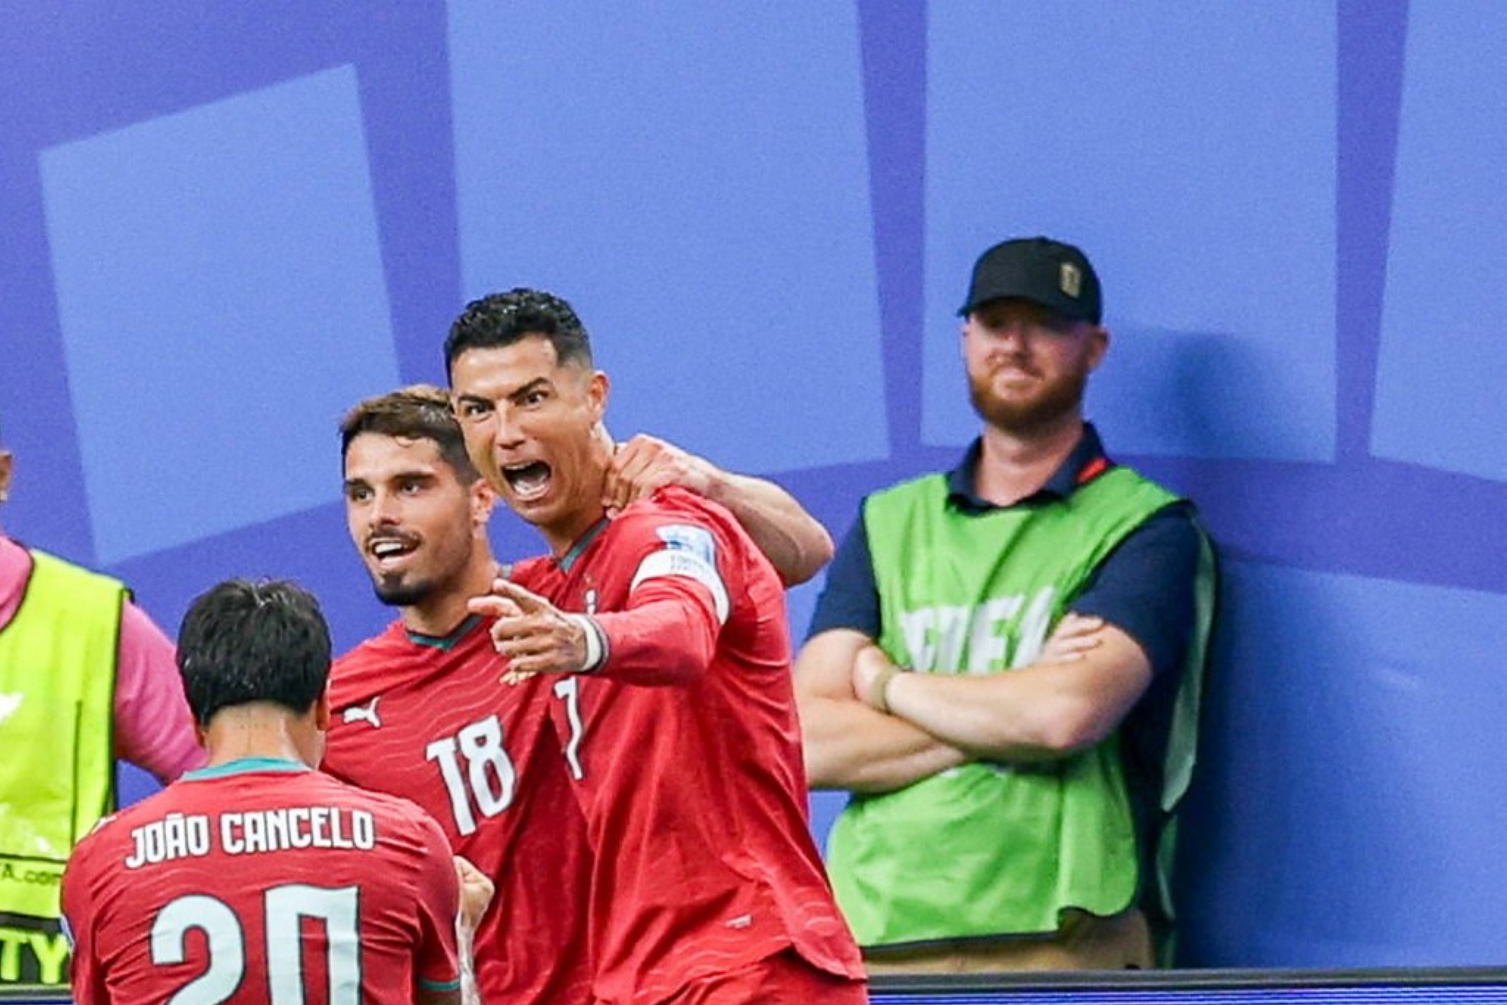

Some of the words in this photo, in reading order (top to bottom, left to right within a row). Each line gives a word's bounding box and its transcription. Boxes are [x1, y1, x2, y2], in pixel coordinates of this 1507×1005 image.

[426, 714, 518, 838] 18
[125, 813, 211, 869] JOÃO
[220, 808, 377, 855] CANCELO
